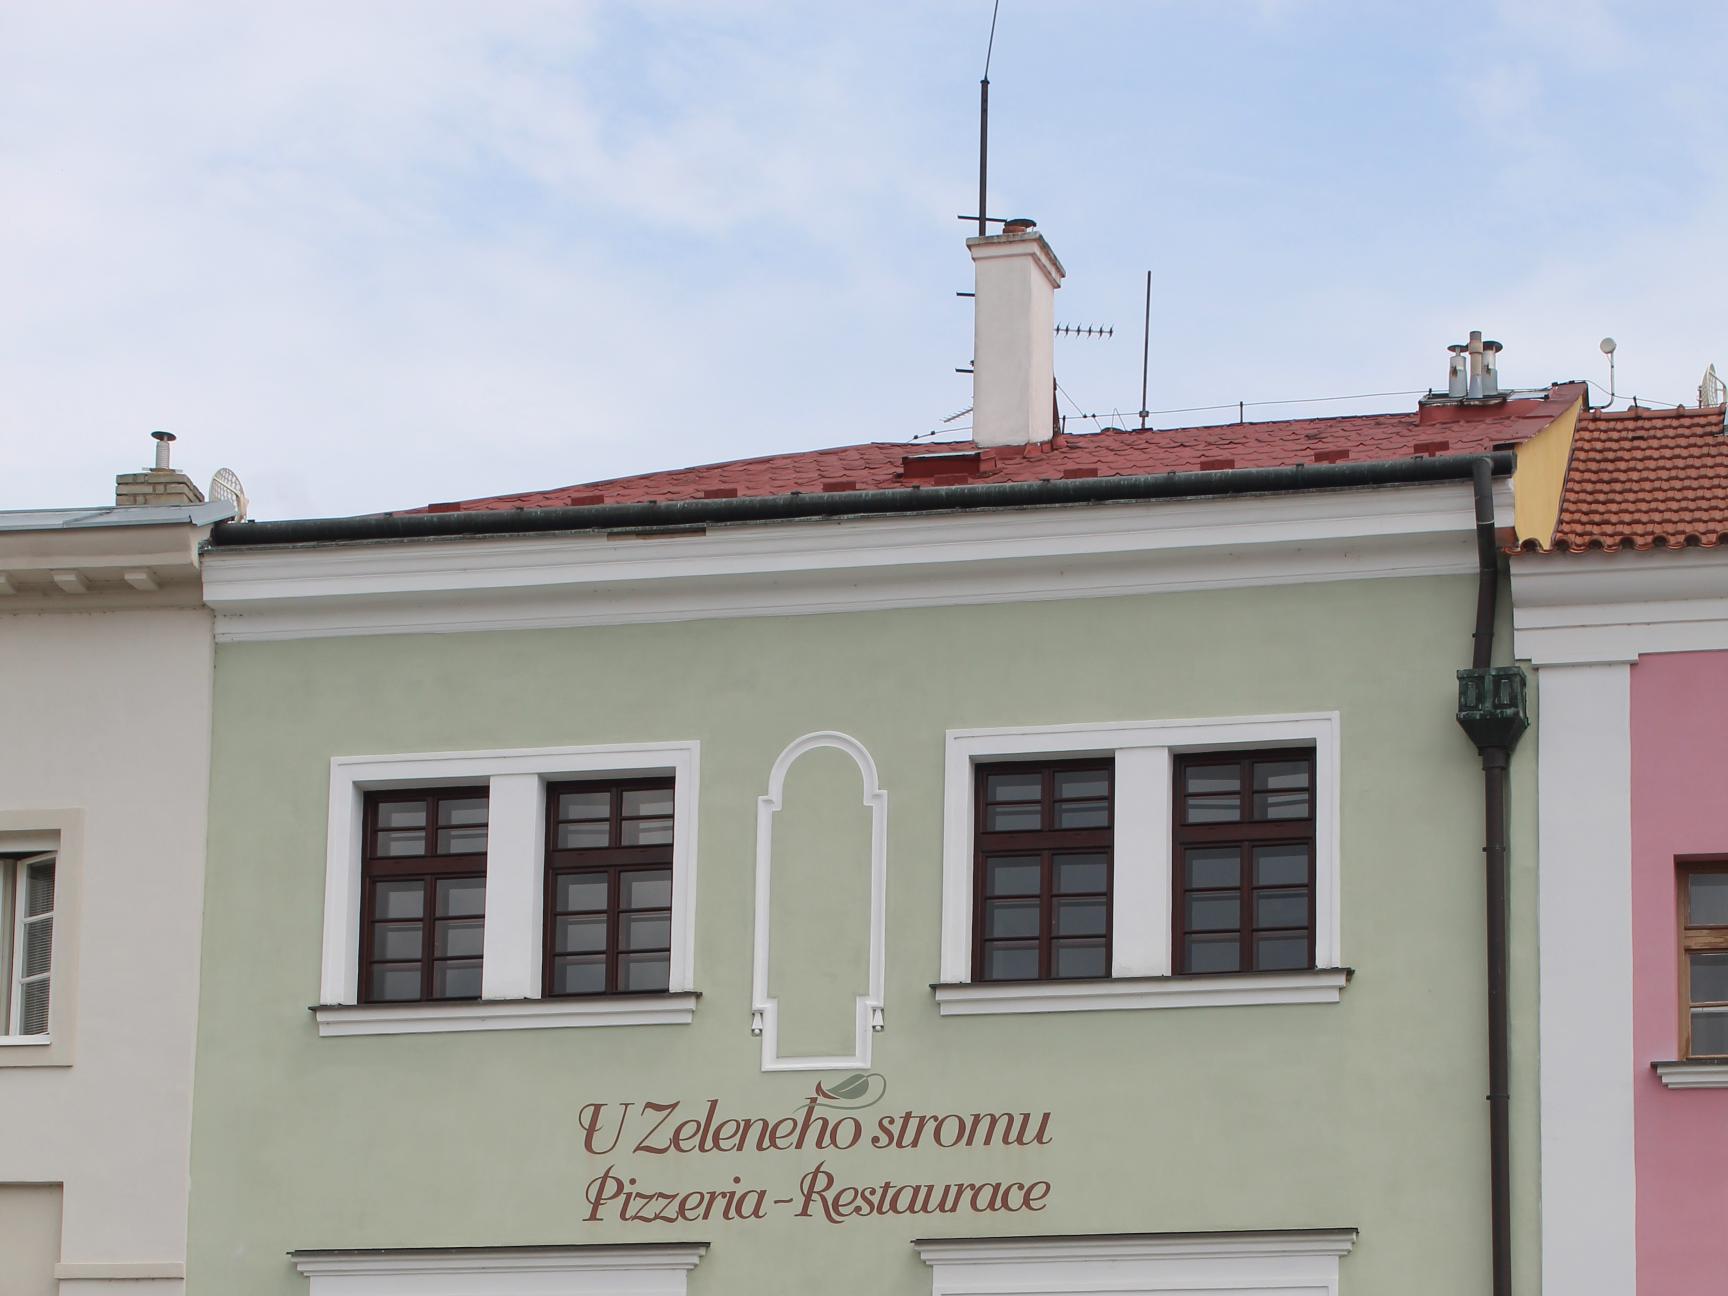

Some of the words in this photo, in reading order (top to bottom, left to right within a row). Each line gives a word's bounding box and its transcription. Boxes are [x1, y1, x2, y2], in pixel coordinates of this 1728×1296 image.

[578, 1102, 636, 1155] U
[871, 1110, 1054, 1149] stromu
[582, 1163, 768, 1224] Pizzeria
[794, 1159, 1052, 1225] Restaurace
